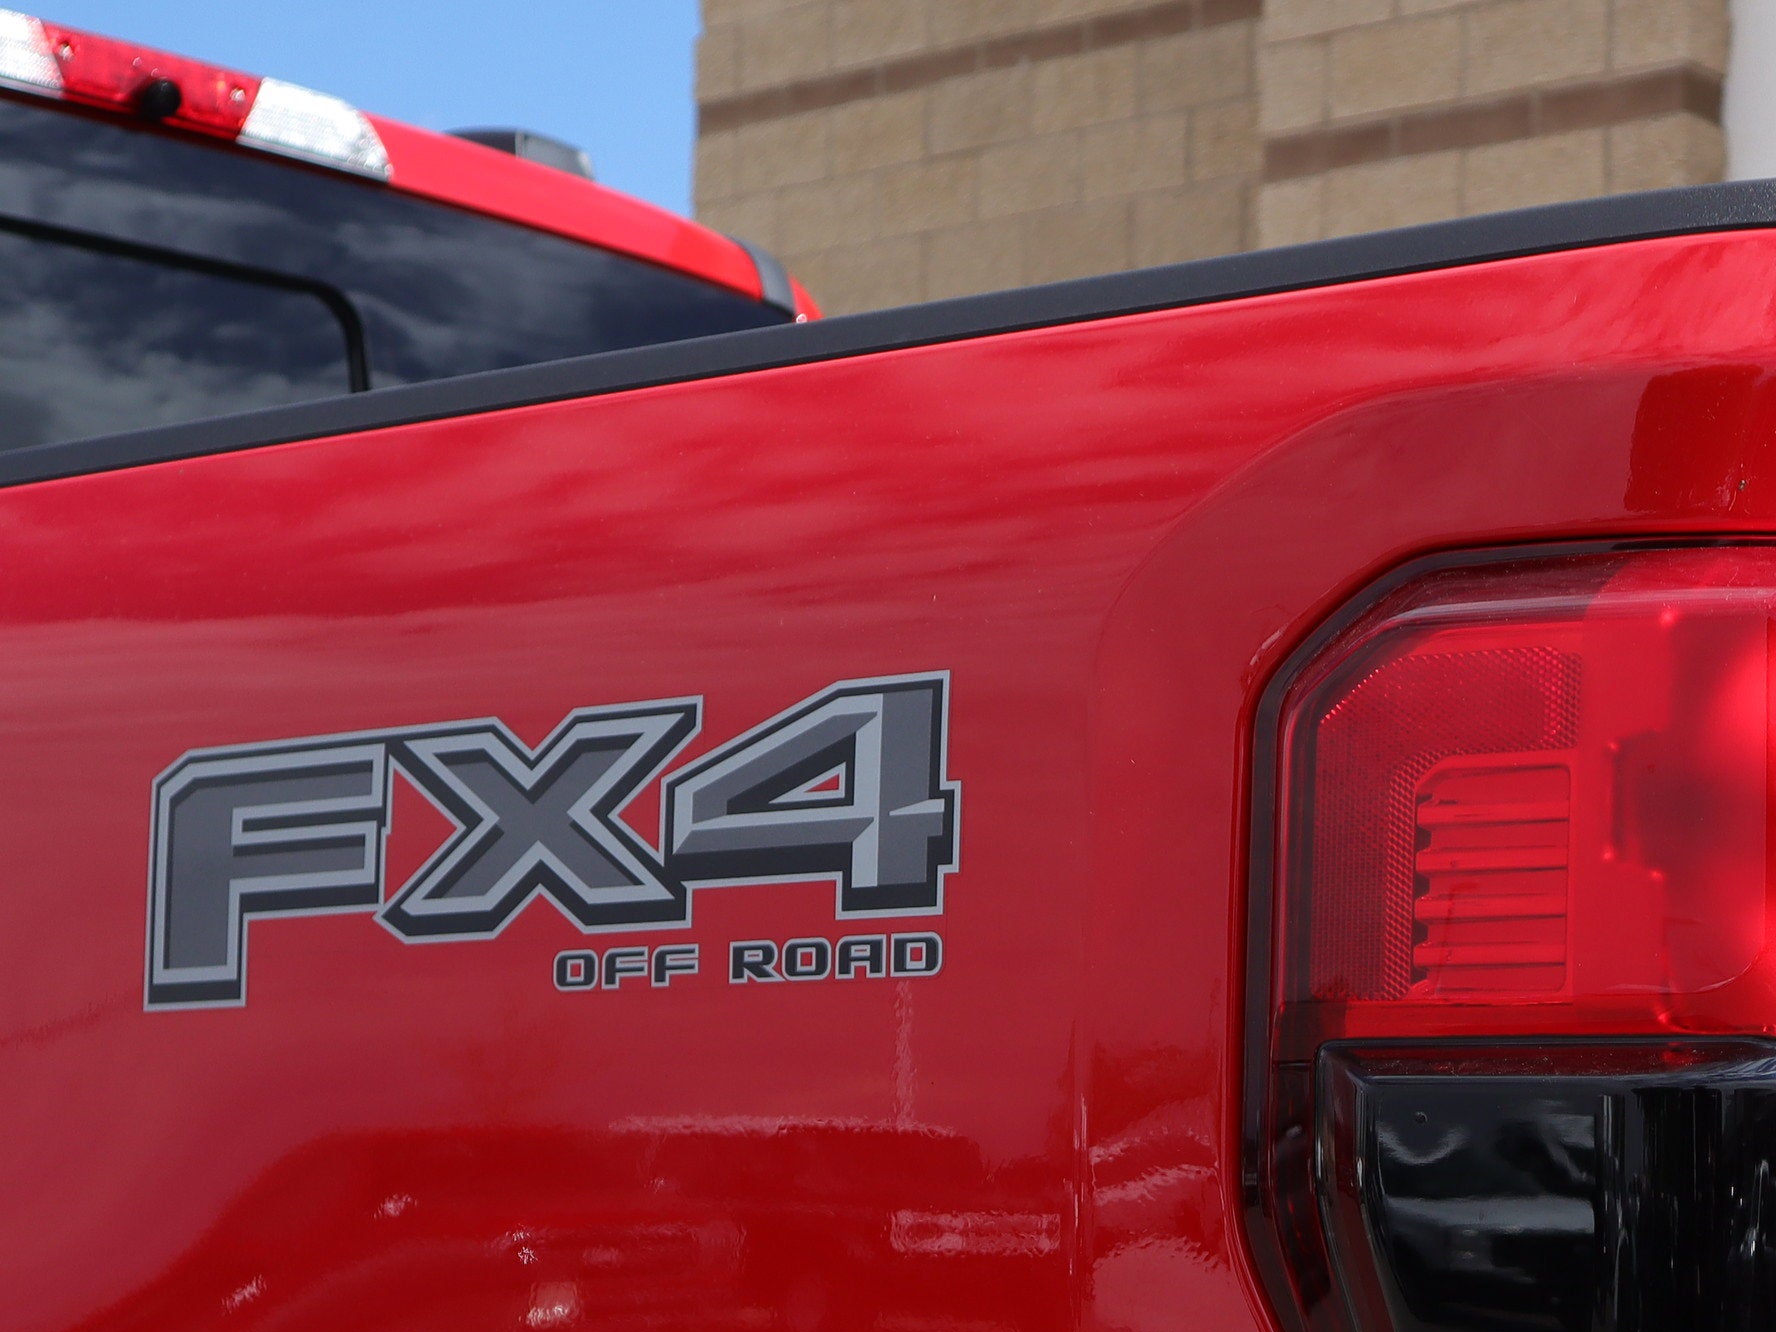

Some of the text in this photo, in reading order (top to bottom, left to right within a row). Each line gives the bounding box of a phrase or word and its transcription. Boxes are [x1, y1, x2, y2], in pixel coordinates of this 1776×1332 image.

[143, 669, 961, 1011] FX4
[553, 932, 943, 991] OFF ROAD
